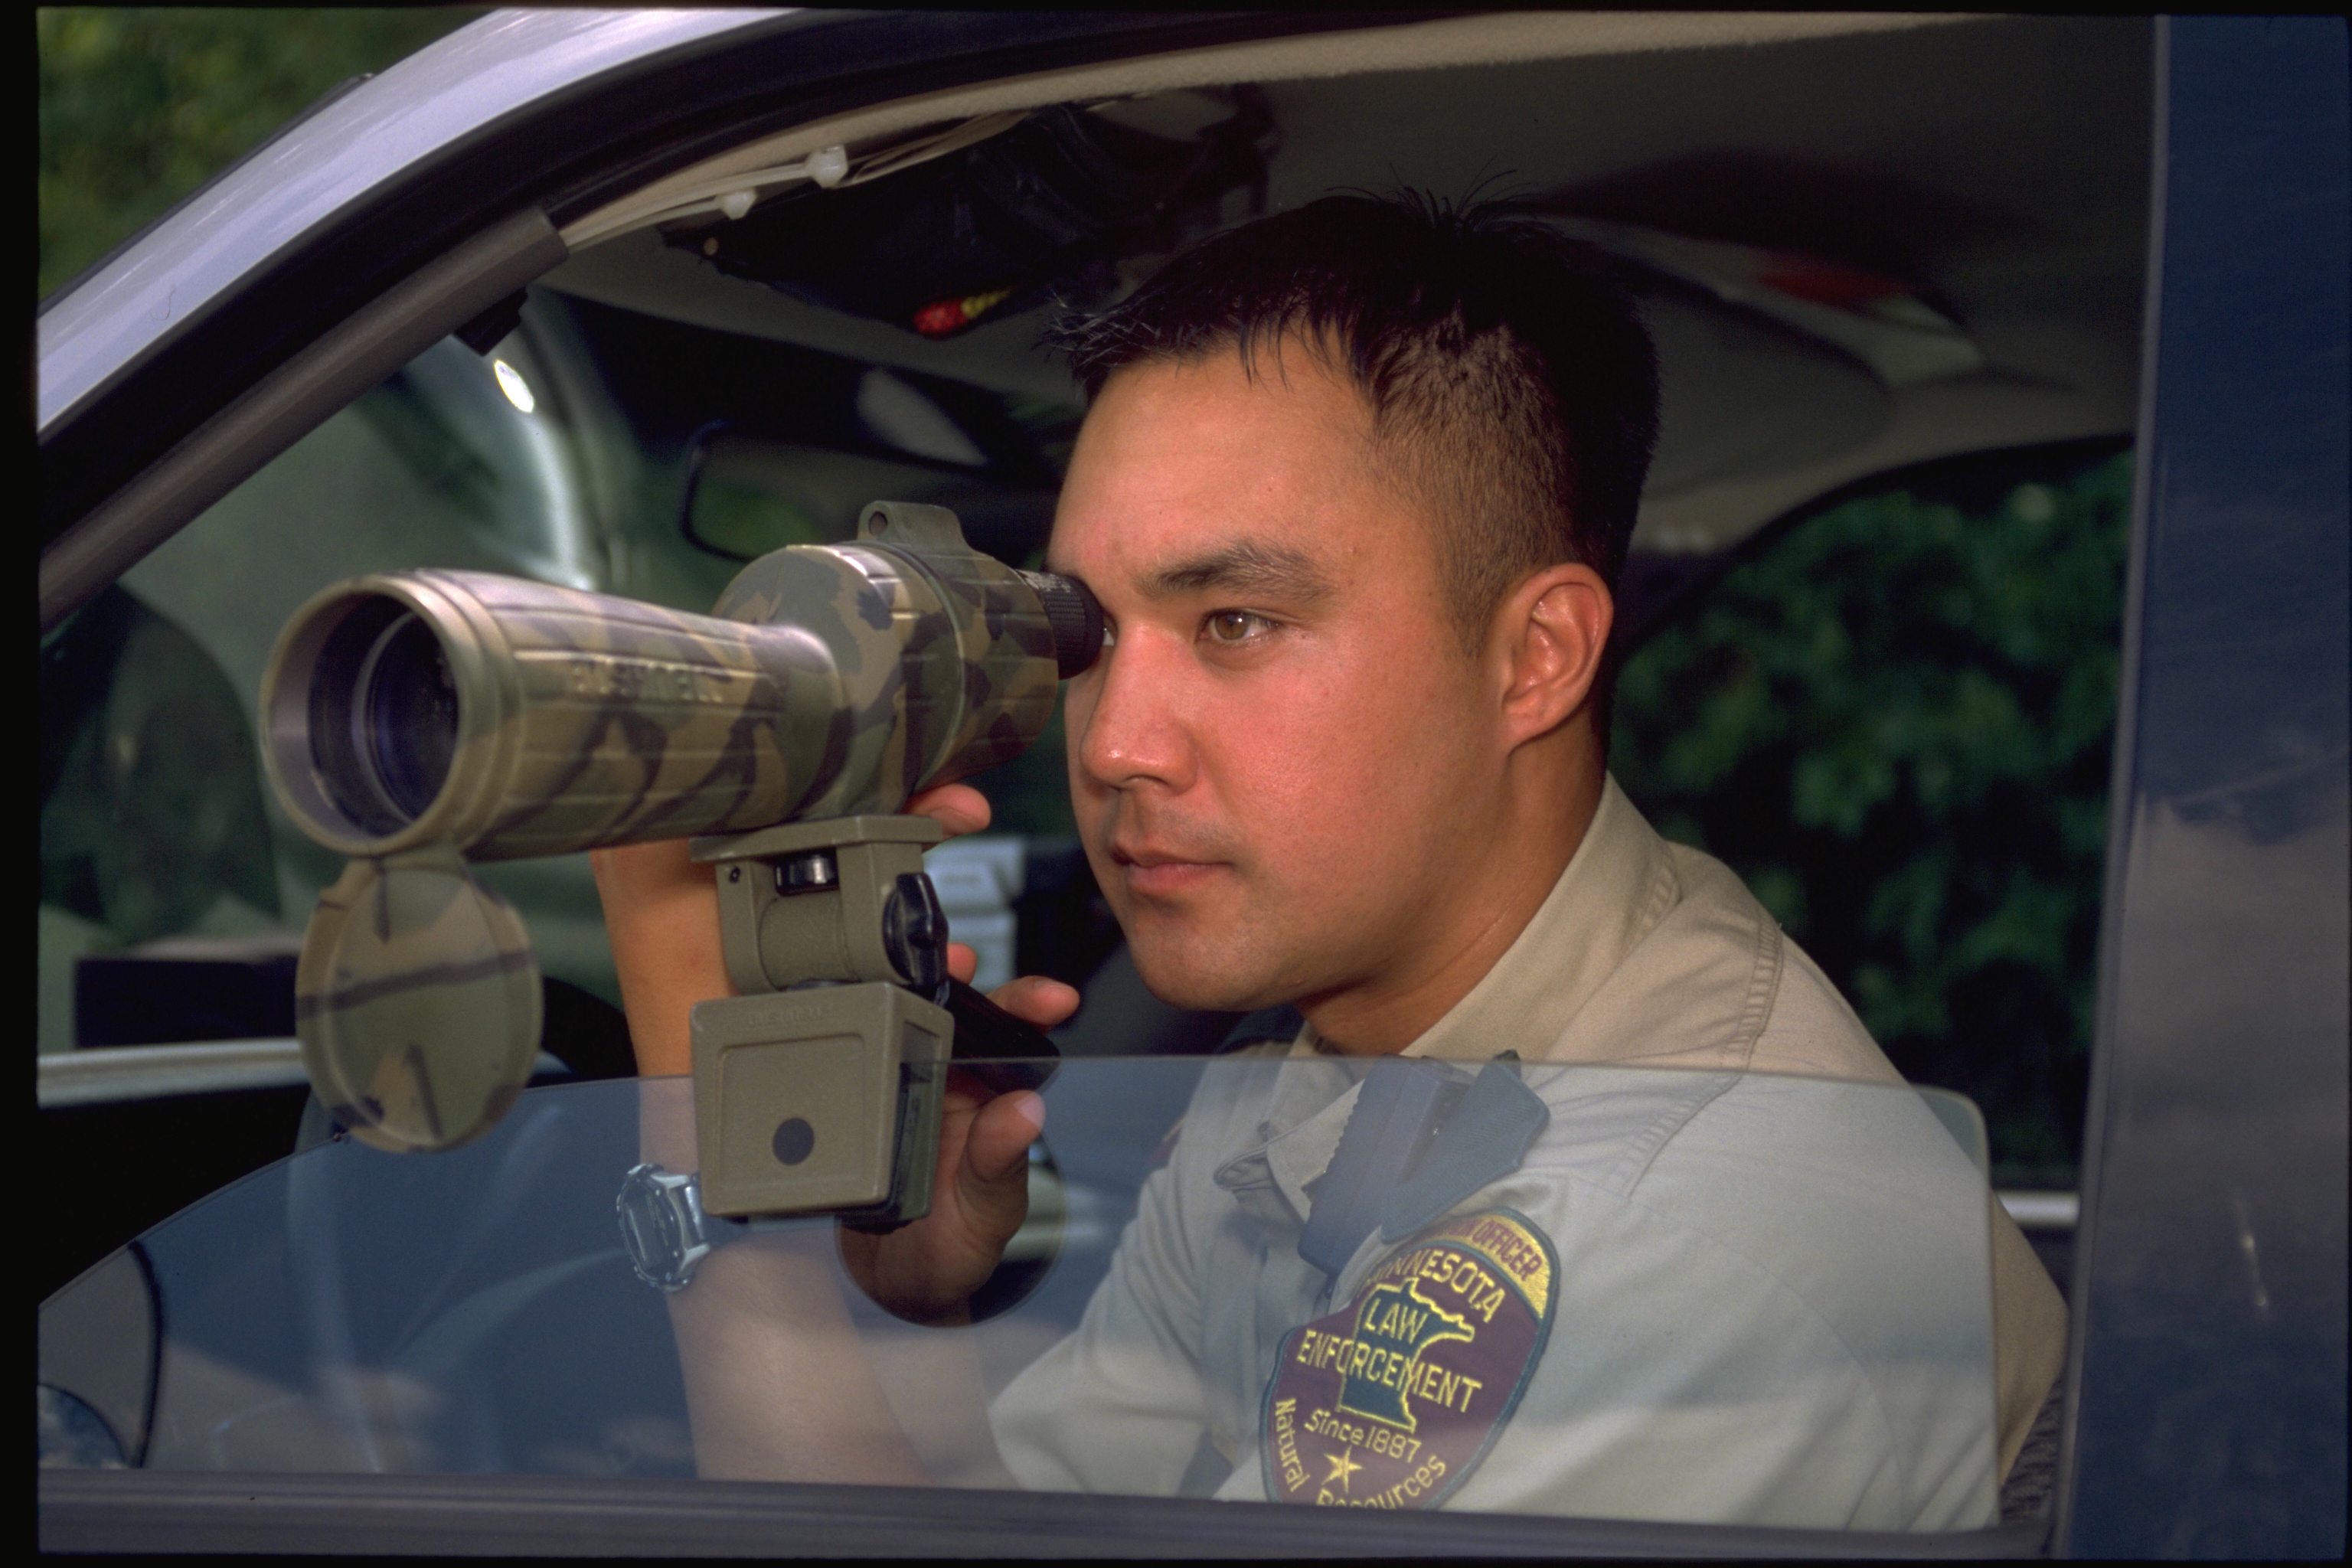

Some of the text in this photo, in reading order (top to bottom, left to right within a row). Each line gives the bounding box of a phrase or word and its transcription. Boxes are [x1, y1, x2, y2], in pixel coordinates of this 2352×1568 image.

[1472, 1220, 1543, 1282] OFFICER
[1363, 1298, 1429, 1344] LAW
[1297, 1328, 1483, 1413] ENFORCEMENT
[1275, 1397, 1311, 1492] Natural
[1304, 1408, 1423, 1463] Since 1887
